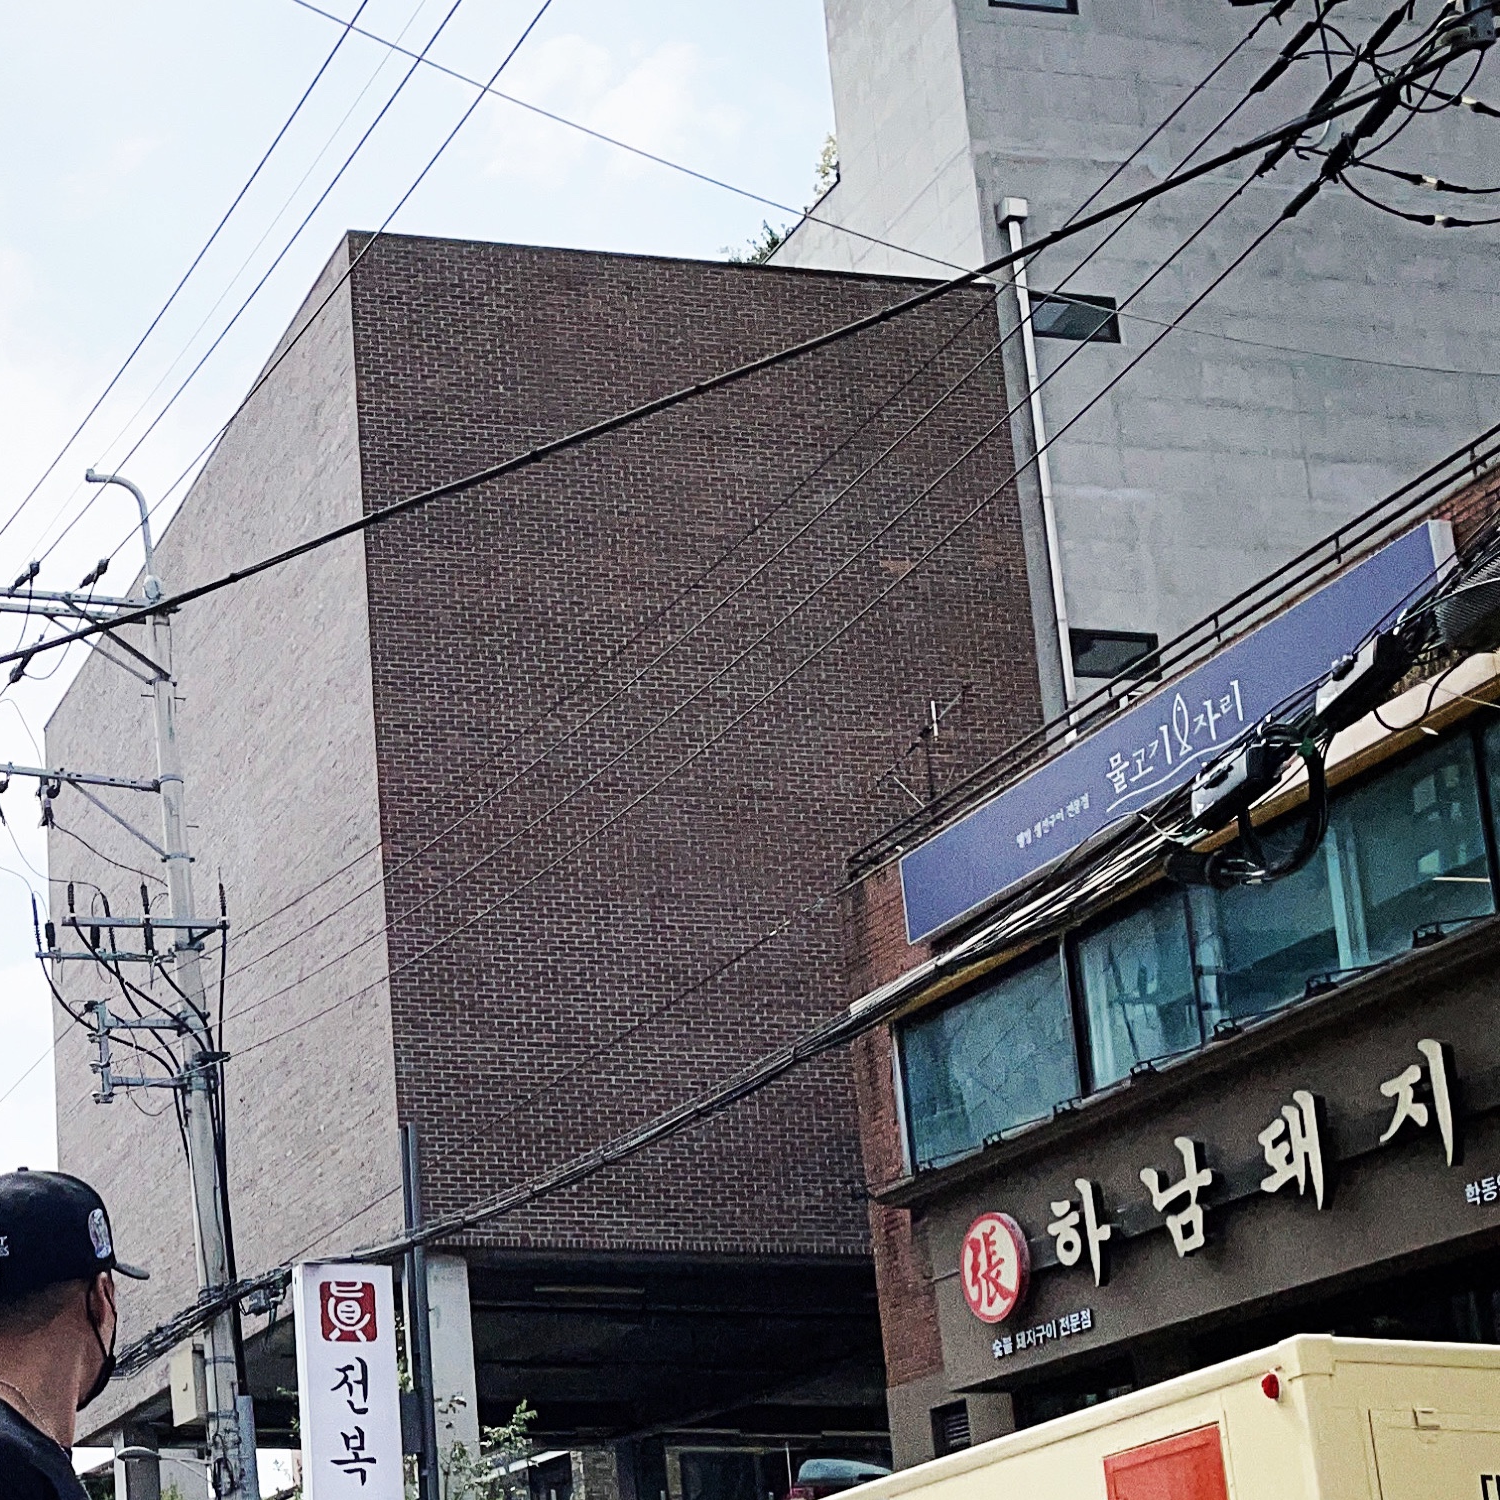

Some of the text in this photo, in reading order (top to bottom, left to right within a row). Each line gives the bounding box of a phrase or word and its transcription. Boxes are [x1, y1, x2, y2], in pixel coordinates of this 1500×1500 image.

[1047, 1038, 1454, 1288] 하남돼지
[964, 1220, 1019, 1314] 張
[1059, 1308, 1092, 1337] 전문점
